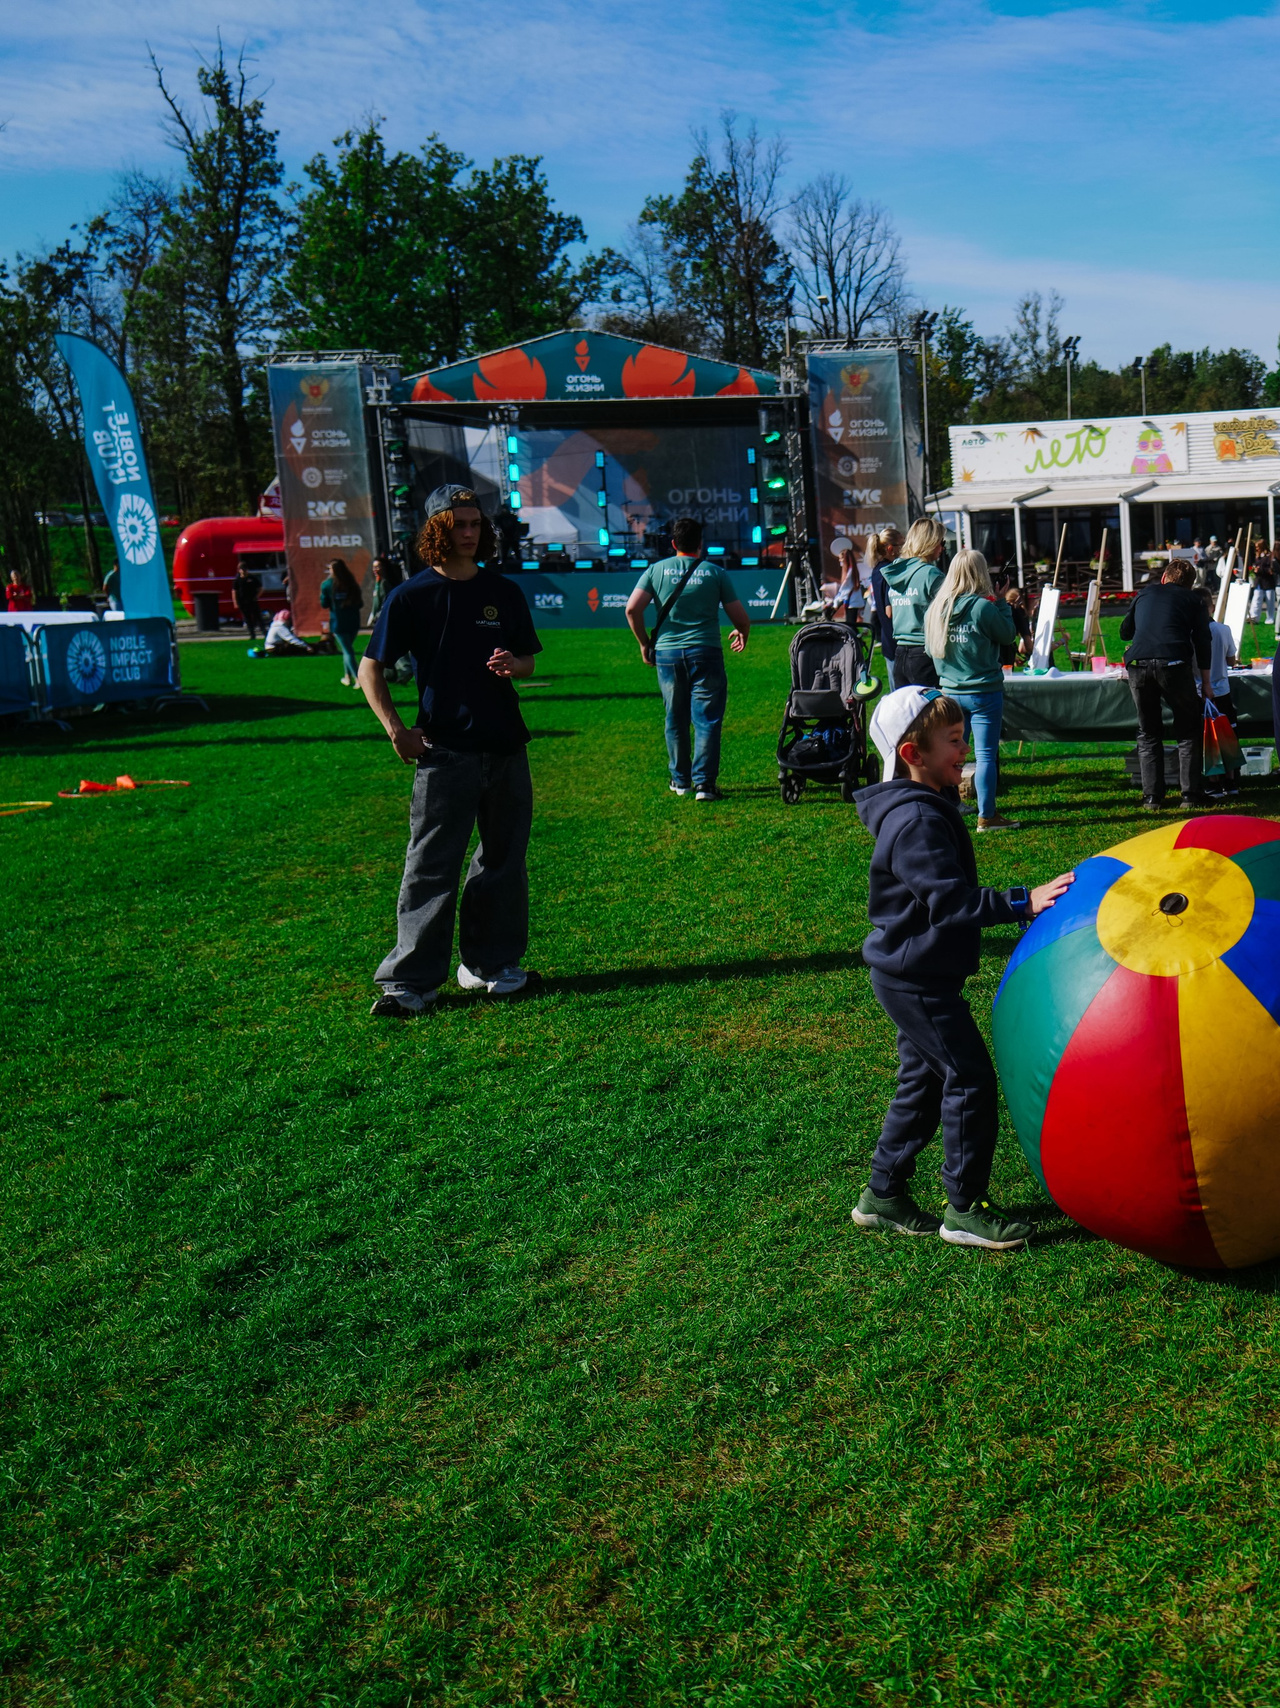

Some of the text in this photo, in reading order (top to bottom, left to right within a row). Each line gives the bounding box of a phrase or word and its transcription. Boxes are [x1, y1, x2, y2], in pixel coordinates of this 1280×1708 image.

[566, 375, 601, 383] ОГОНЬ
[565, 384, 605, 392] ЖИЗНИ
[848, 428, 888, 438] ЖИЗНИ
[668, 488, 742, 504] ОГОНЬ
[665, 506, 749, 523] ЖИЗНИ
[313, 534, 363, 548] MAER
[110, 635, 146, 651] NOBLE
[111, 650, 152, 667] IMPACT
[112, 666, 141, 682] CLUB
